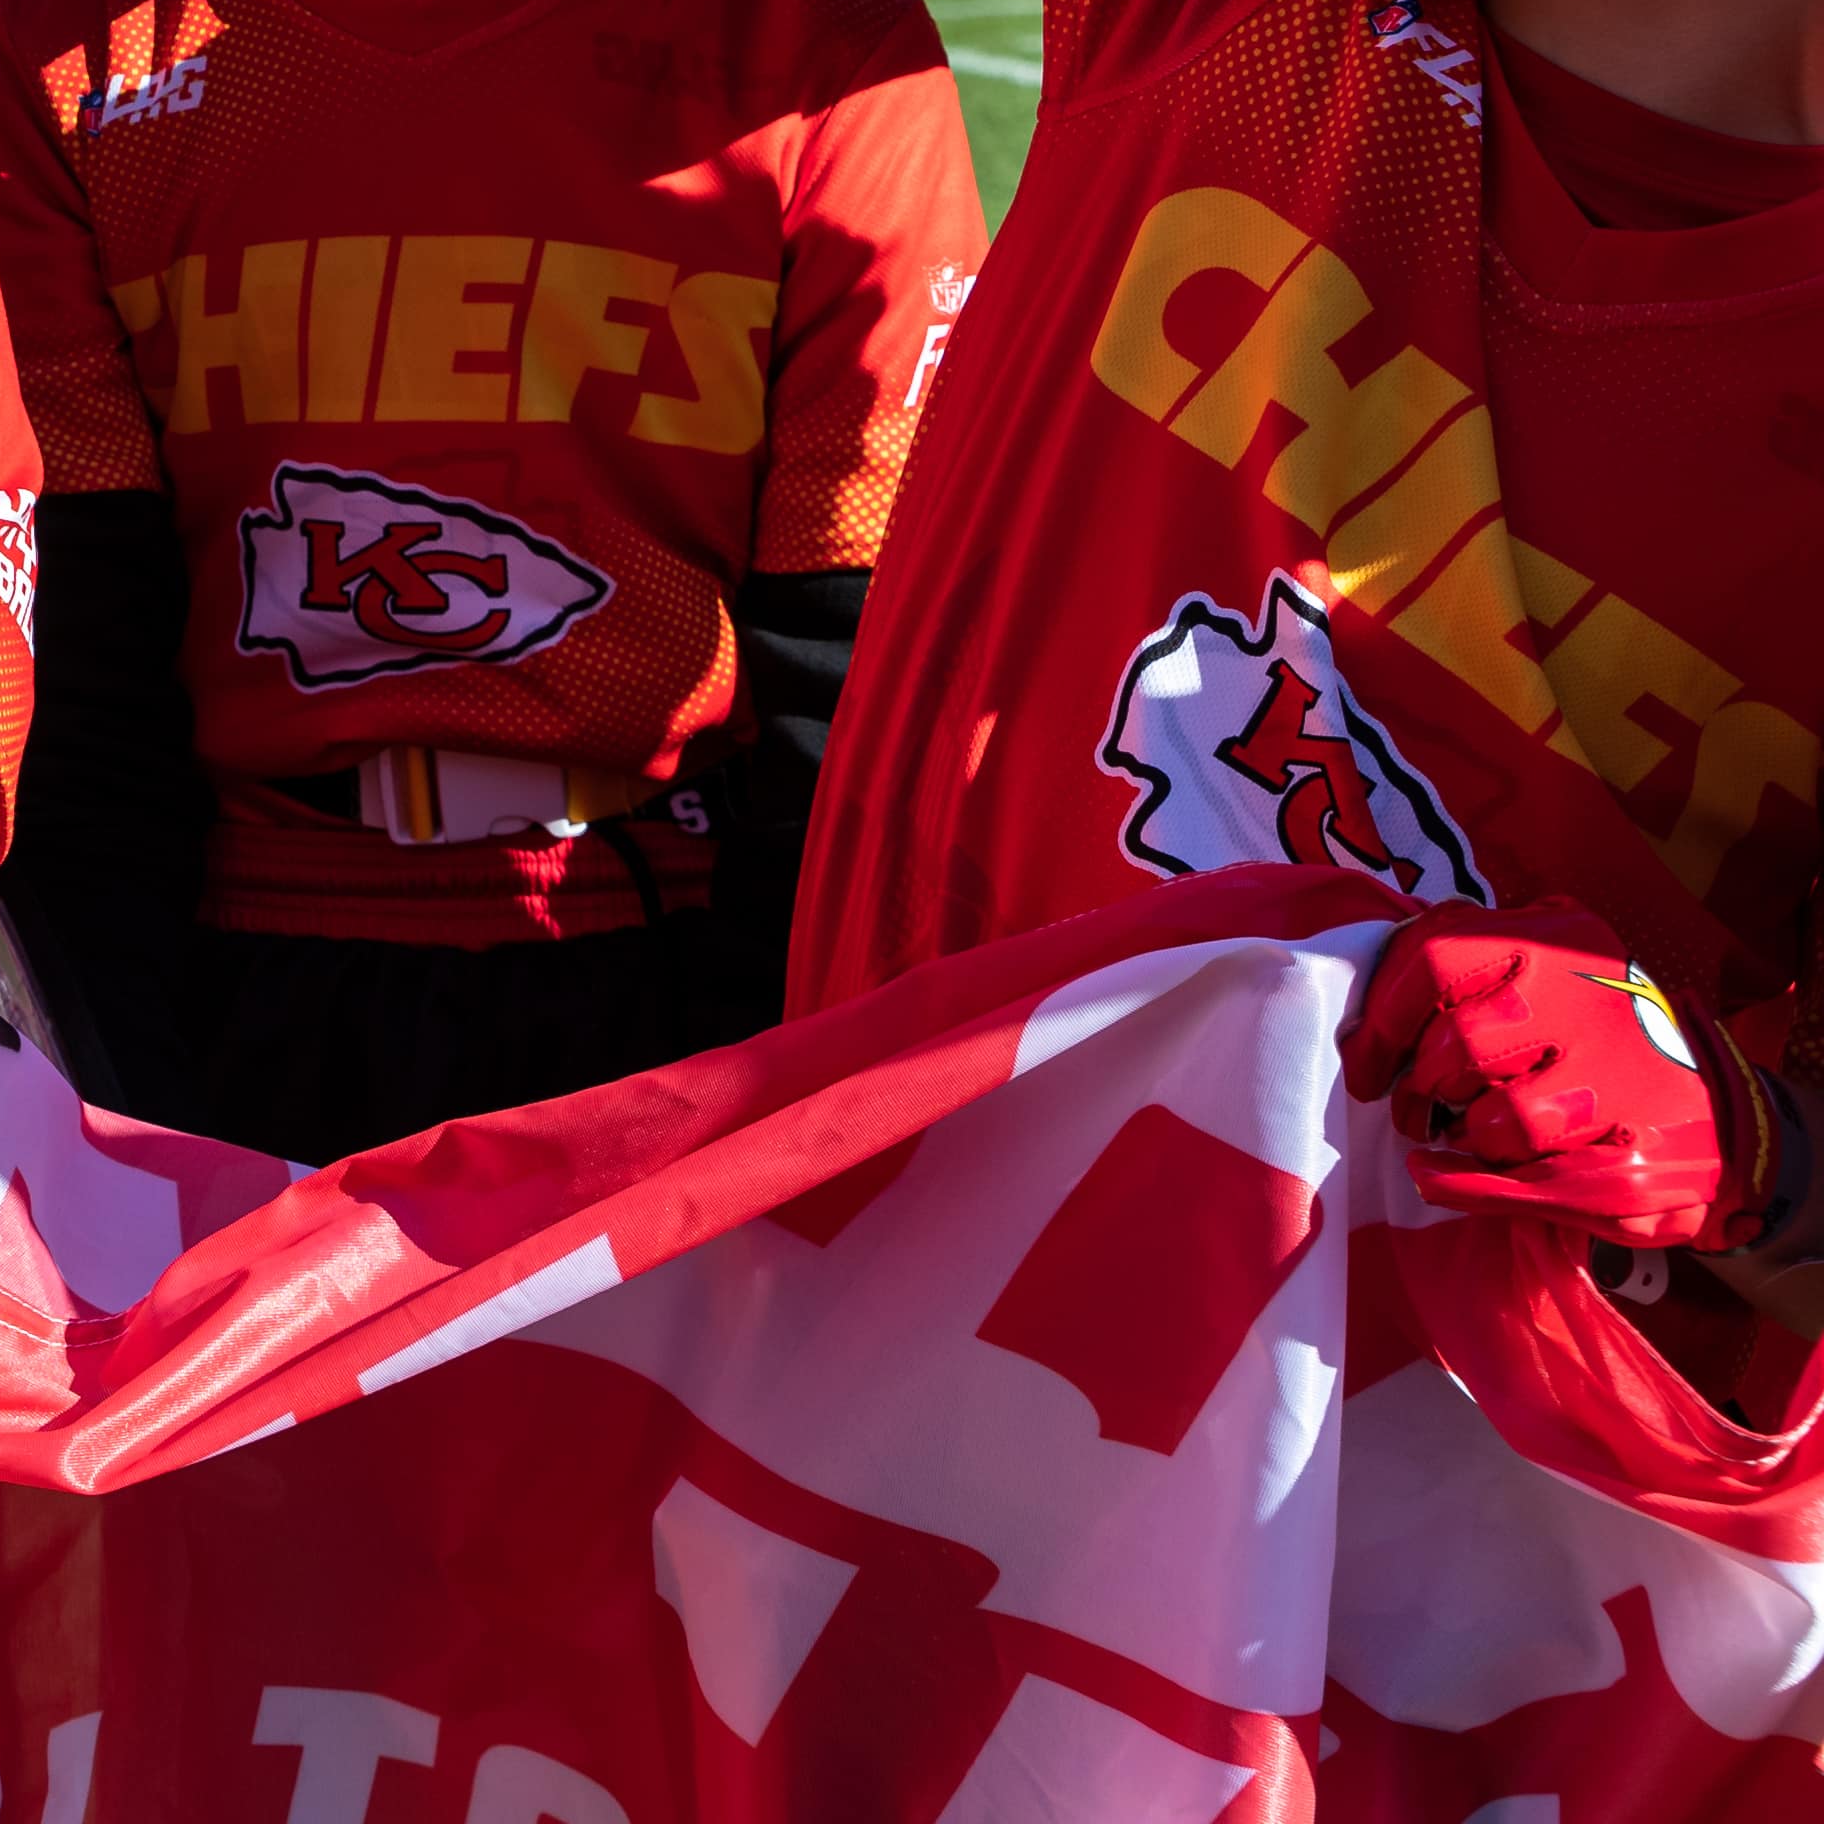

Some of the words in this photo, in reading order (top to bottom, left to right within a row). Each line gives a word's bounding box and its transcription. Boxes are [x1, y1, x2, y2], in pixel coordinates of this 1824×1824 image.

[102, 55, 209, 127] LAG
[112, 234, 780, 456] HIEFS
[298, 517, 512, 652] KC
[1090, 186, 1822, 901] CHIEFS
